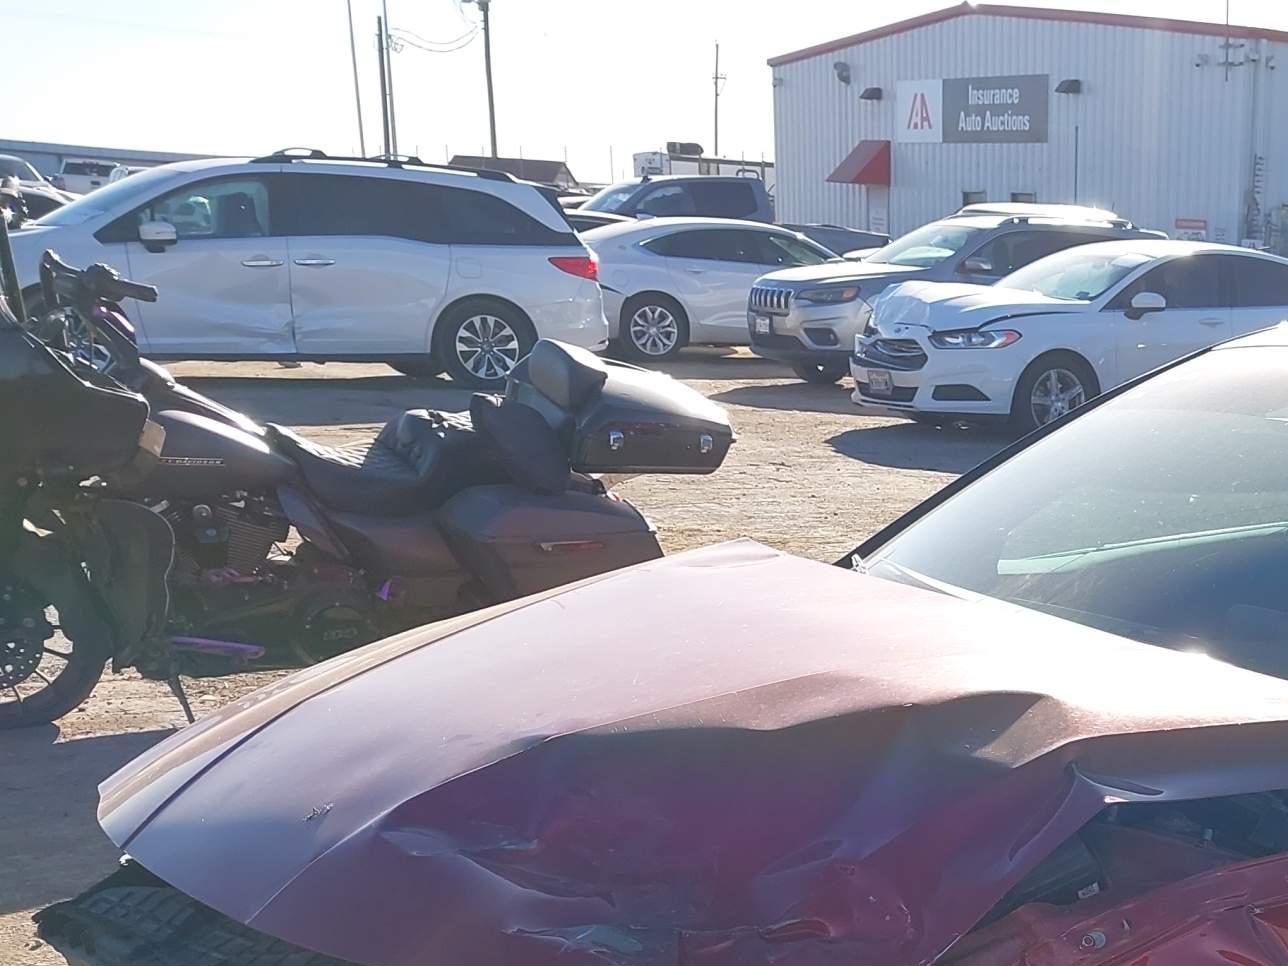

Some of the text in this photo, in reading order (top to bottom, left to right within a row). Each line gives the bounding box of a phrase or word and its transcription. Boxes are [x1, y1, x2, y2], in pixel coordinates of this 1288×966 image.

[968, 84, 1020, 105] Insurance
[958, 110, 1030, 131] Auto Auctions
